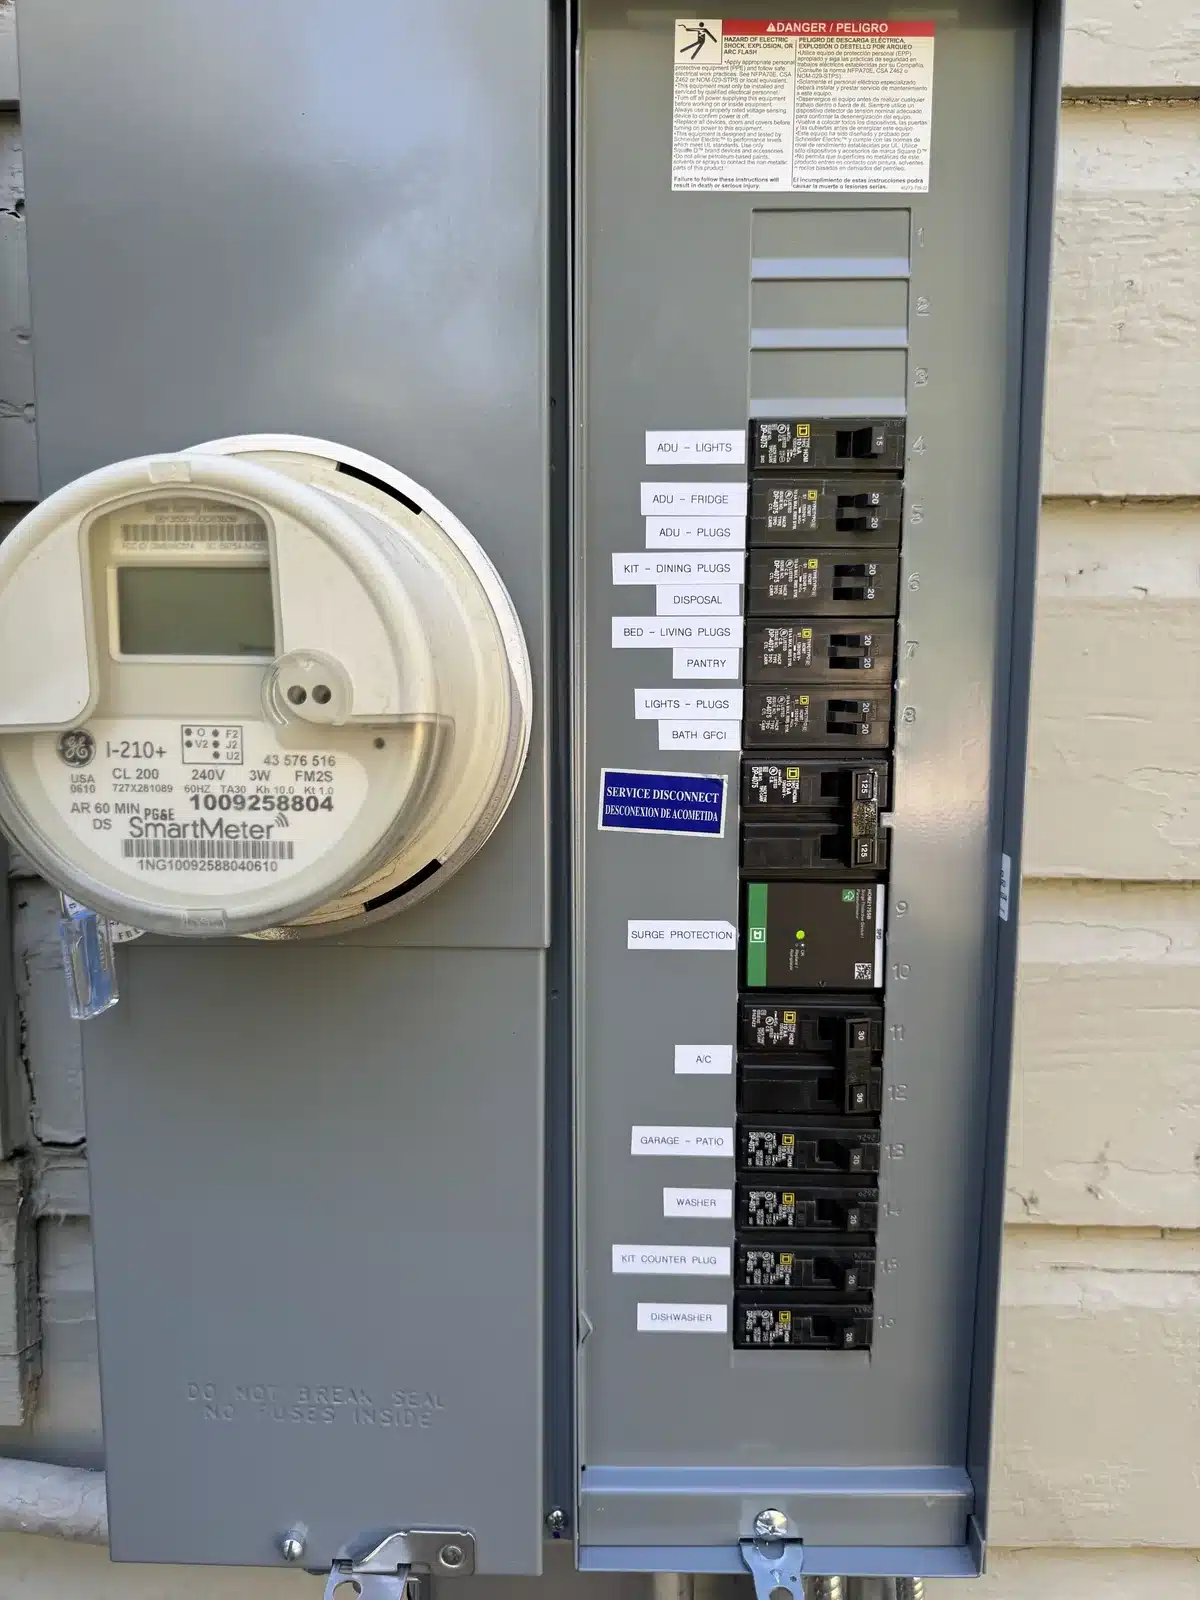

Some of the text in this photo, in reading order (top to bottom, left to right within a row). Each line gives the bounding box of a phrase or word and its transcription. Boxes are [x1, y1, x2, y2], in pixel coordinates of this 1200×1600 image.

[777, 24, 826, 32] DANGER
[836, 24, 888, 33] PELIGRO
[658, 443, 679, 452] ADU
[696, 442, 732, 452] LIGHTS
[875, 437, 883, 446] 15
[912, 436, 927, 455] 4
[653, 495, 674, 504] ADU
[691, 494, 728, 504] FRIDGE
[871, 493, 879, 504] 20
[910, 504, 924, 524] 5
[870, 517, 879, 528] 20
[659, 528, 680, 537] ADU
[697, 528, 730, 537] PLUGS
[624, 564, 639, 573] KIT
[656, 564, 691, 573] DINING
[697, 563, 730, 573] PLUGS
[869, 564, 877, 575] 20
[867, 588, 875, 599] 20
[674, 596, 722, 604] DISPOSAL
[624, 628, 644, 637] BED
[661, 628, 692, 637] LIVING
[698, 627, 731, 637] PLUGS
[864, 635, 872, 646] 20
[687, 660, 726, 668] PANTRY
[863, 657, 871, 669] 20
[645, 700, 680, 709] LIGHTS
[697, 700, 729, 709] PLUGS
[862, 703, 870, 714] 20
[226, 730, 238, 738] F2
[861, 724, 869, 735] 20
[672, 731, 727, 740] BATH GFCI
[106, 741, 167, 759] I-210+
[195, 740, 238, 749] V2 J2
[226, 752, 239, 760] U2
[263, 755, 335, 767] 43 576 516
[71, 774, 94, 785] USA
[112, 769, 333, 782] CL 200 240V 3W FM2S
[70, 784, 96, 794] 0610
[112, 784, 334, 794] 727X281089 60HZ TA30 Kh 10.0 Kt 1.0
[607, 786, 719, 804] SERVICE DISCONNECT
[71, 803, 139, 814] AR 60 MIN
[190, 794, 334, 812] 1009258804
[144, 808, 175, 821] PG&E
[605, 805, 718, 822] DESCONEXION DE ACOMETIDA
[93, 819, 112, 830] DS
[129, 817, 274, 839] SmartMeter
[860, 843, 868, 857] 125
[138, 859, 278, 872] 1NG10092588040610
[631, 931, 733, 939] SURGE PROTECTION
[892, 963, 911, 980] 10
[857, 1030, 865, 1041] 30
[696, 1055, 711, 1064] A/C
[856, 1092, 864, 1103] 30
[641, 1136, 679, 1145] GARAGE
[696, 1137, 723, 1146] PATIO
[852, 1155, 860, 1165] 20
[677, 1198, 716, 1207] WASHER
[849, 1215, 857, 1225] 20
[622, 1255, 716, 1265] KIT COUNTER PLUG
[848, 1275, 855, 1285] 20
[651, 1313, 712, 1322] DISHWASHER
[846, 1333, 853, 1342] 20
[188, 1382, 444, 1409] DO NOT BREAK SEAL
[353, 1408, 433, 1428] INSIDE
